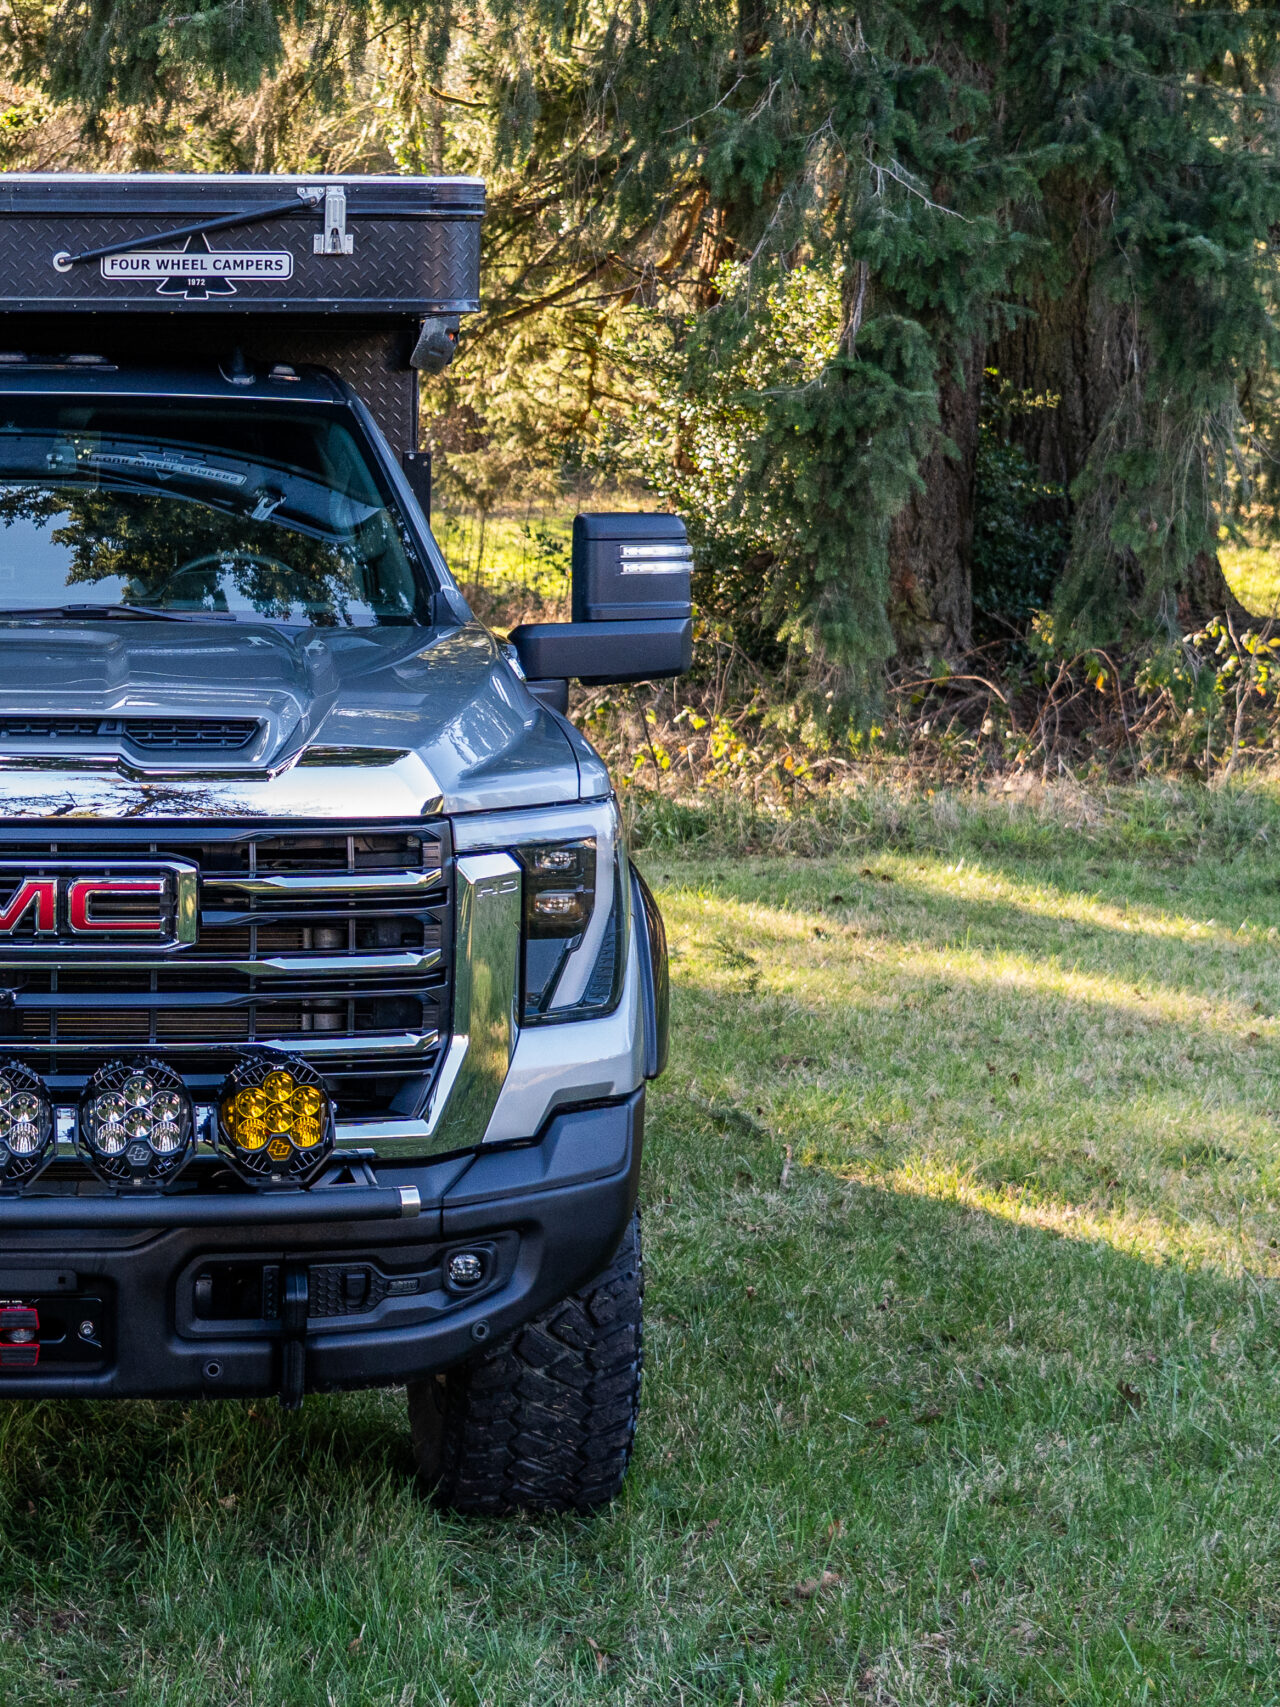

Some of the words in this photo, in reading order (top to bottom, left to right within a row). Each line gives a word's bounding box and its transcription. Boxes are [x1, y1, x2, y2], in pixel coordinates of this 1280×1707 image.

[110, 259, 151, 271] FOUR
[156, 259, 208, 271] WHEEL
[212, 259, 284, 271] CAMPERS
[187, 278, 206, 287] 1972
